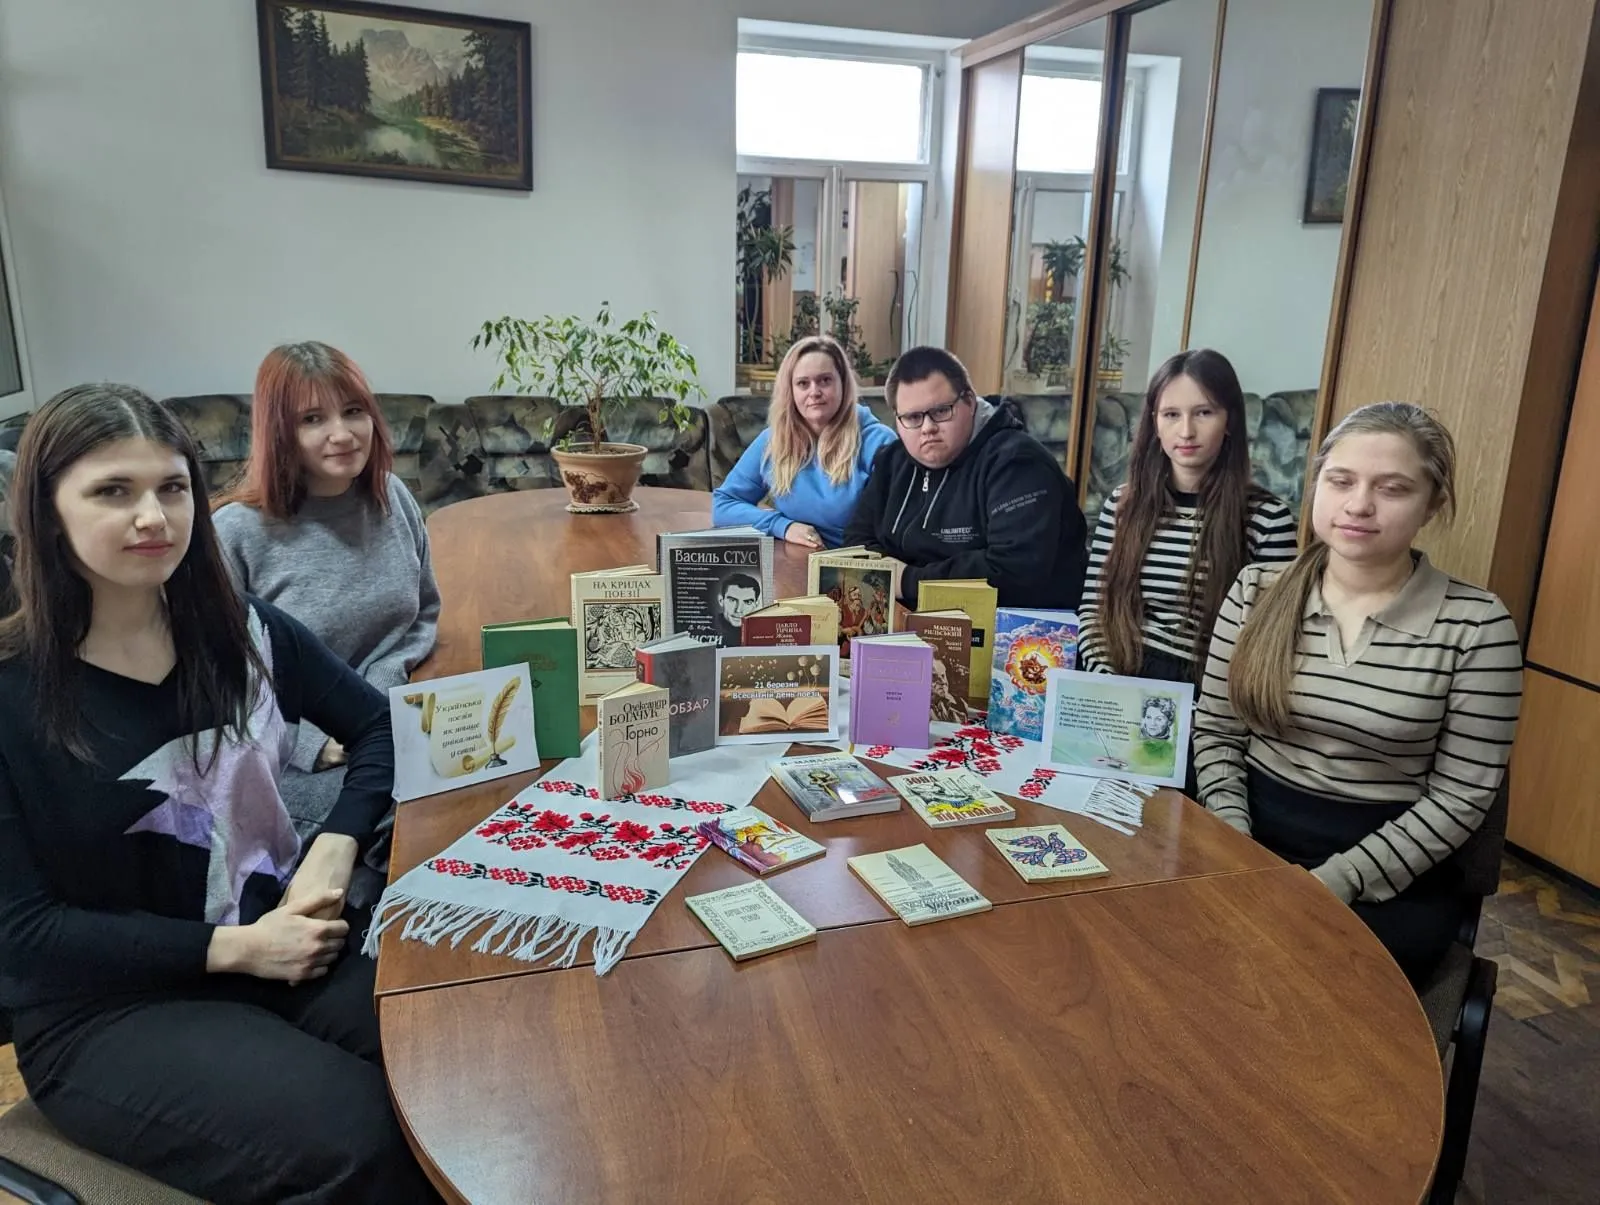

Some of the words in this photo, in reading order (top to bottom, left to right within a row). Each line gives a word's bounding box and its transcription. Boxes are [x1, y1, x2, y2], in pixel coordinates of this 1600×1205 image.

[675, 549, 720, 563] Василь
[723, 550, 757, 564] СТУС
[593, 581, 607, 589] НА
[611, 580, 651, 589] КРИЛАХ
[604, 589, 640, 598] ПОЕЗІЇ
[754, 681, 764, 689] 21
[766, 681, 799, 689] березня
[732, 691, 774, 699] Всесвітній
[775, 691, 795, 699] день
[623, 699, 667, 713] Олександр
[669, 698, 709, 716] ОБЗАР
[609, 708, 658, 725] БОГАЧУК
[626, 724, 658, 755] Горно
